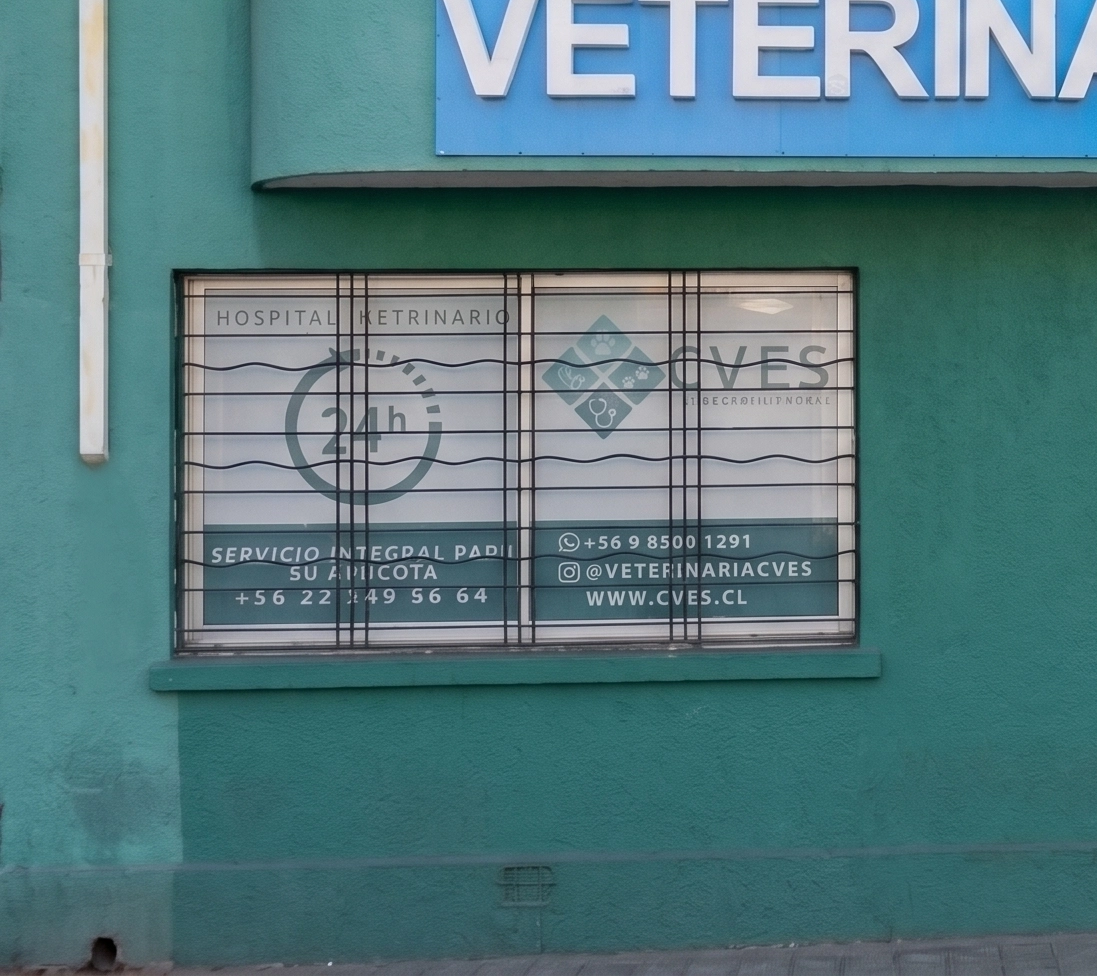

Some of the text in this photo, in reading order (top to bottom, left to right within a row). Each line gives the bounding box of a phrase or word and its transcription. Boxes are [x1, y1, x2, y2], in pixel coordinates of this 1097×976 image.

[217, 309, 337, 326] HOSPITAL
[669, 344, 829, 390] CVES
[321, 406, 406, 455] 24h
[584, 534, 750, 550] +56 9 8500 1291
[211, 546, 320, 563] SERVICIO
[290, 566, 317, 581] SU
[586, 560, 812, 581] @VETERINARIACVES
[235, 589, 285, 605] +56
[301, 589, 331, 605] 22
[411, 587, 442, 604] 56
[456, 587, 488, 604] 64
[586, 589, 748, 606] WWW.CVES.CL
